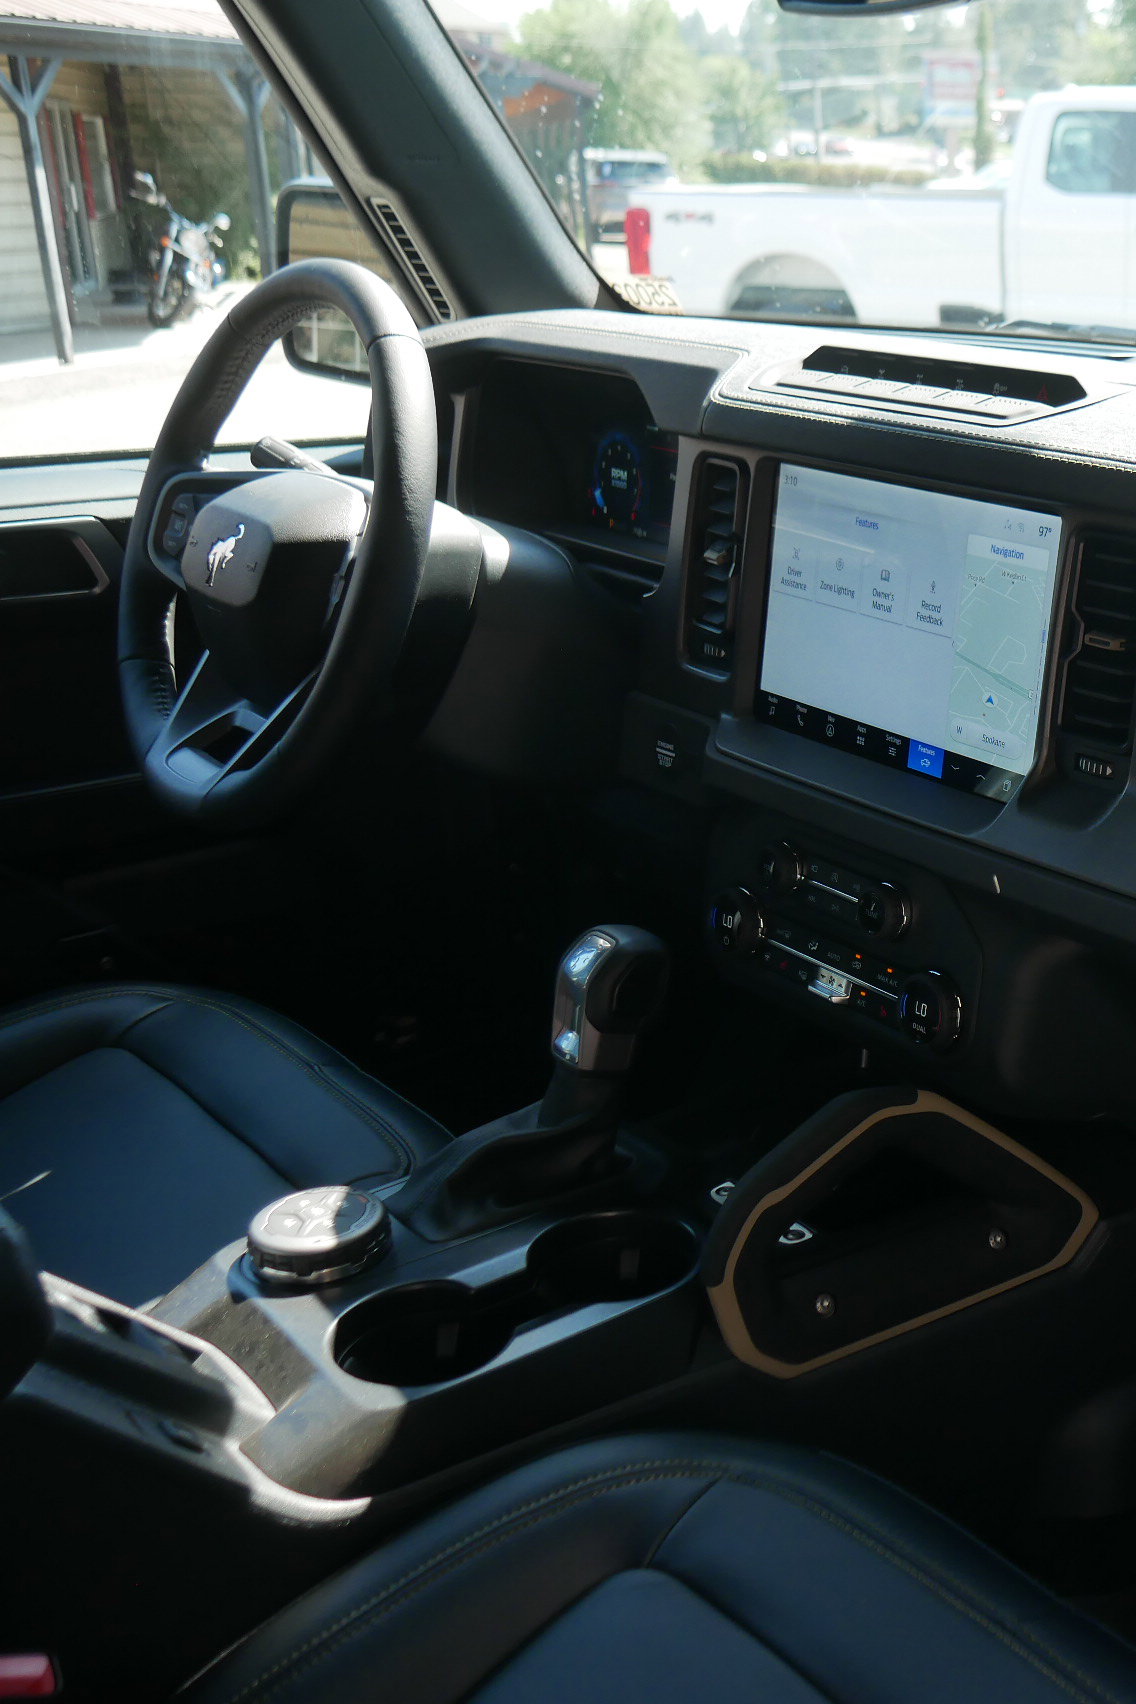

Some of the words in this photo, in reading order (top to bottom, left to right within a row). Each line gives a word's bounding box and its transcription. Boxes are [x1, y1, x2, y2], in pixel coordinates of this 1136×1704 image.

[611, 467, 628, 480] RPM
[784, 475, 798, 487] 3:10
[856, 517, 879, 530] Features
[991, 544, 1024, 560] Navigation
[788, 566, 802, 577] Driver
[781, 577, 807, 591] Assistance
[820, 581, 833, 592] Zone
[834, 584, 855, 599] Lighting
[872, 588, 894, 601] Owner's
[872, 601, 892, 613] Manual
[922, 600, 941, 613] Record
[916, 612, 943, 627] Feedback
[885, 734, 901, 745] Settings
[956, 726, 962, 735] W
[982, 734, 1006, 749] Spokane
[918, 744, 935, 756] Features
[722, 913, 734, 929] LO
[915, 1001, 928, 1018] LO
[912, 1022, 927, 1035] DUAL
